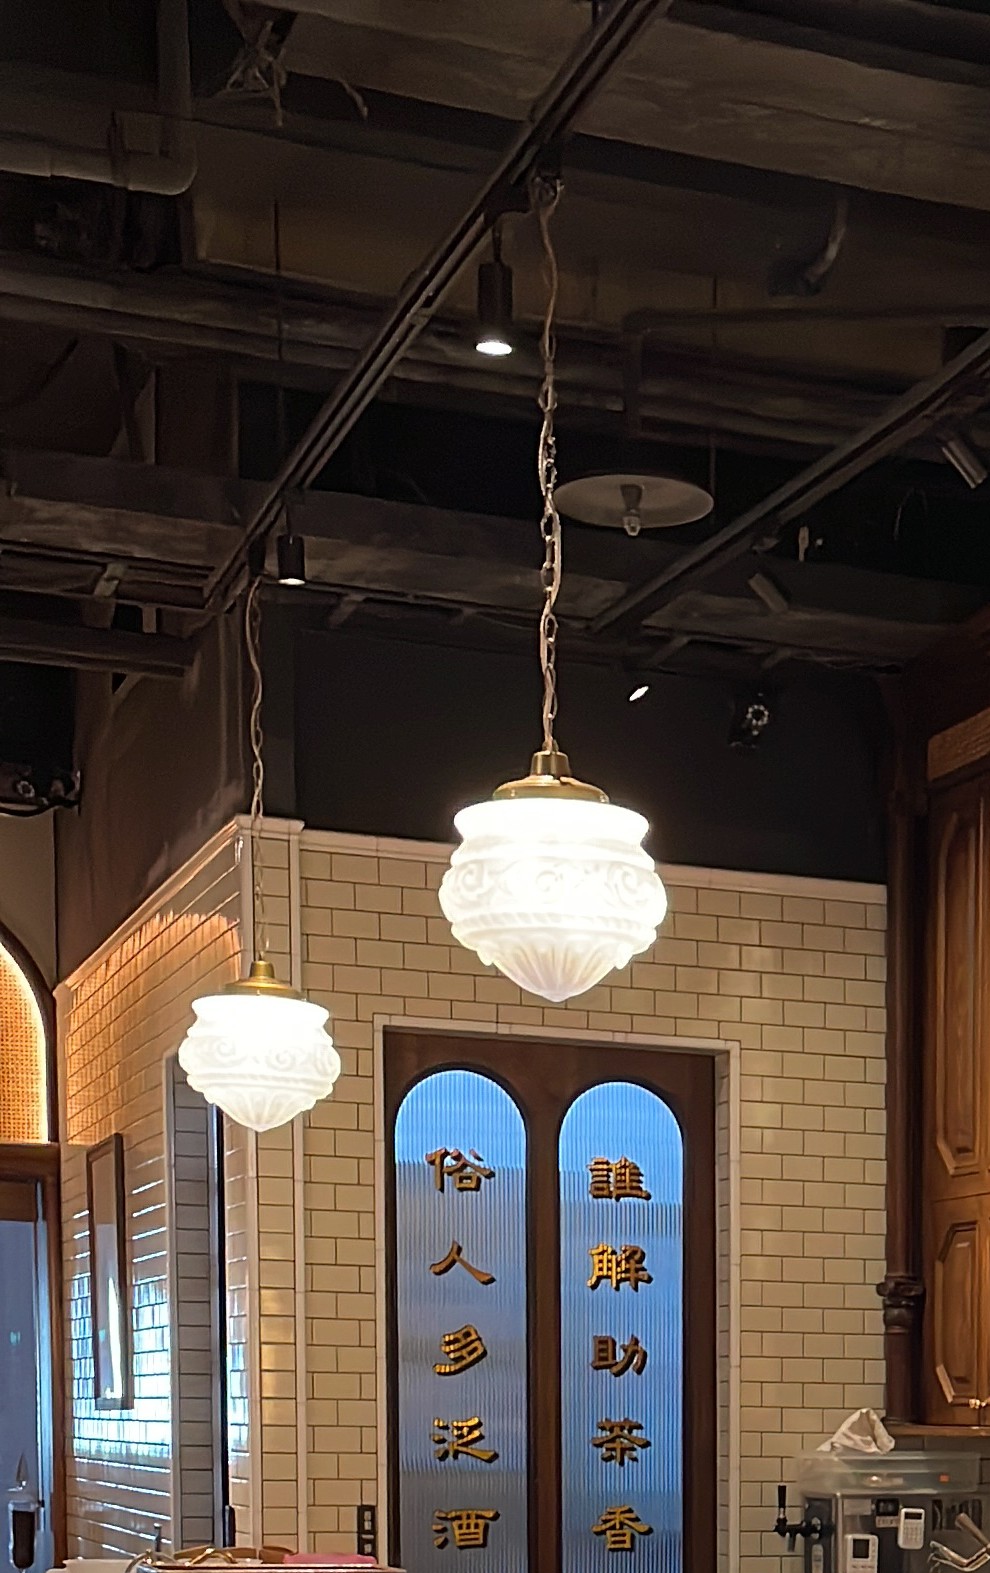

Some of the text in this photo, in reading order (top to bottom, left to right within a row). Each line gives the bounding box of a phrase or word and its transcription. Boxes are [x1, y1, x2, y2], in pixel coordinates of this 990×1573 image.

[425, 1147, 500, 1550] 俗人多泛酒
[587, 1155, 654, 1553] 誰解助茶香
